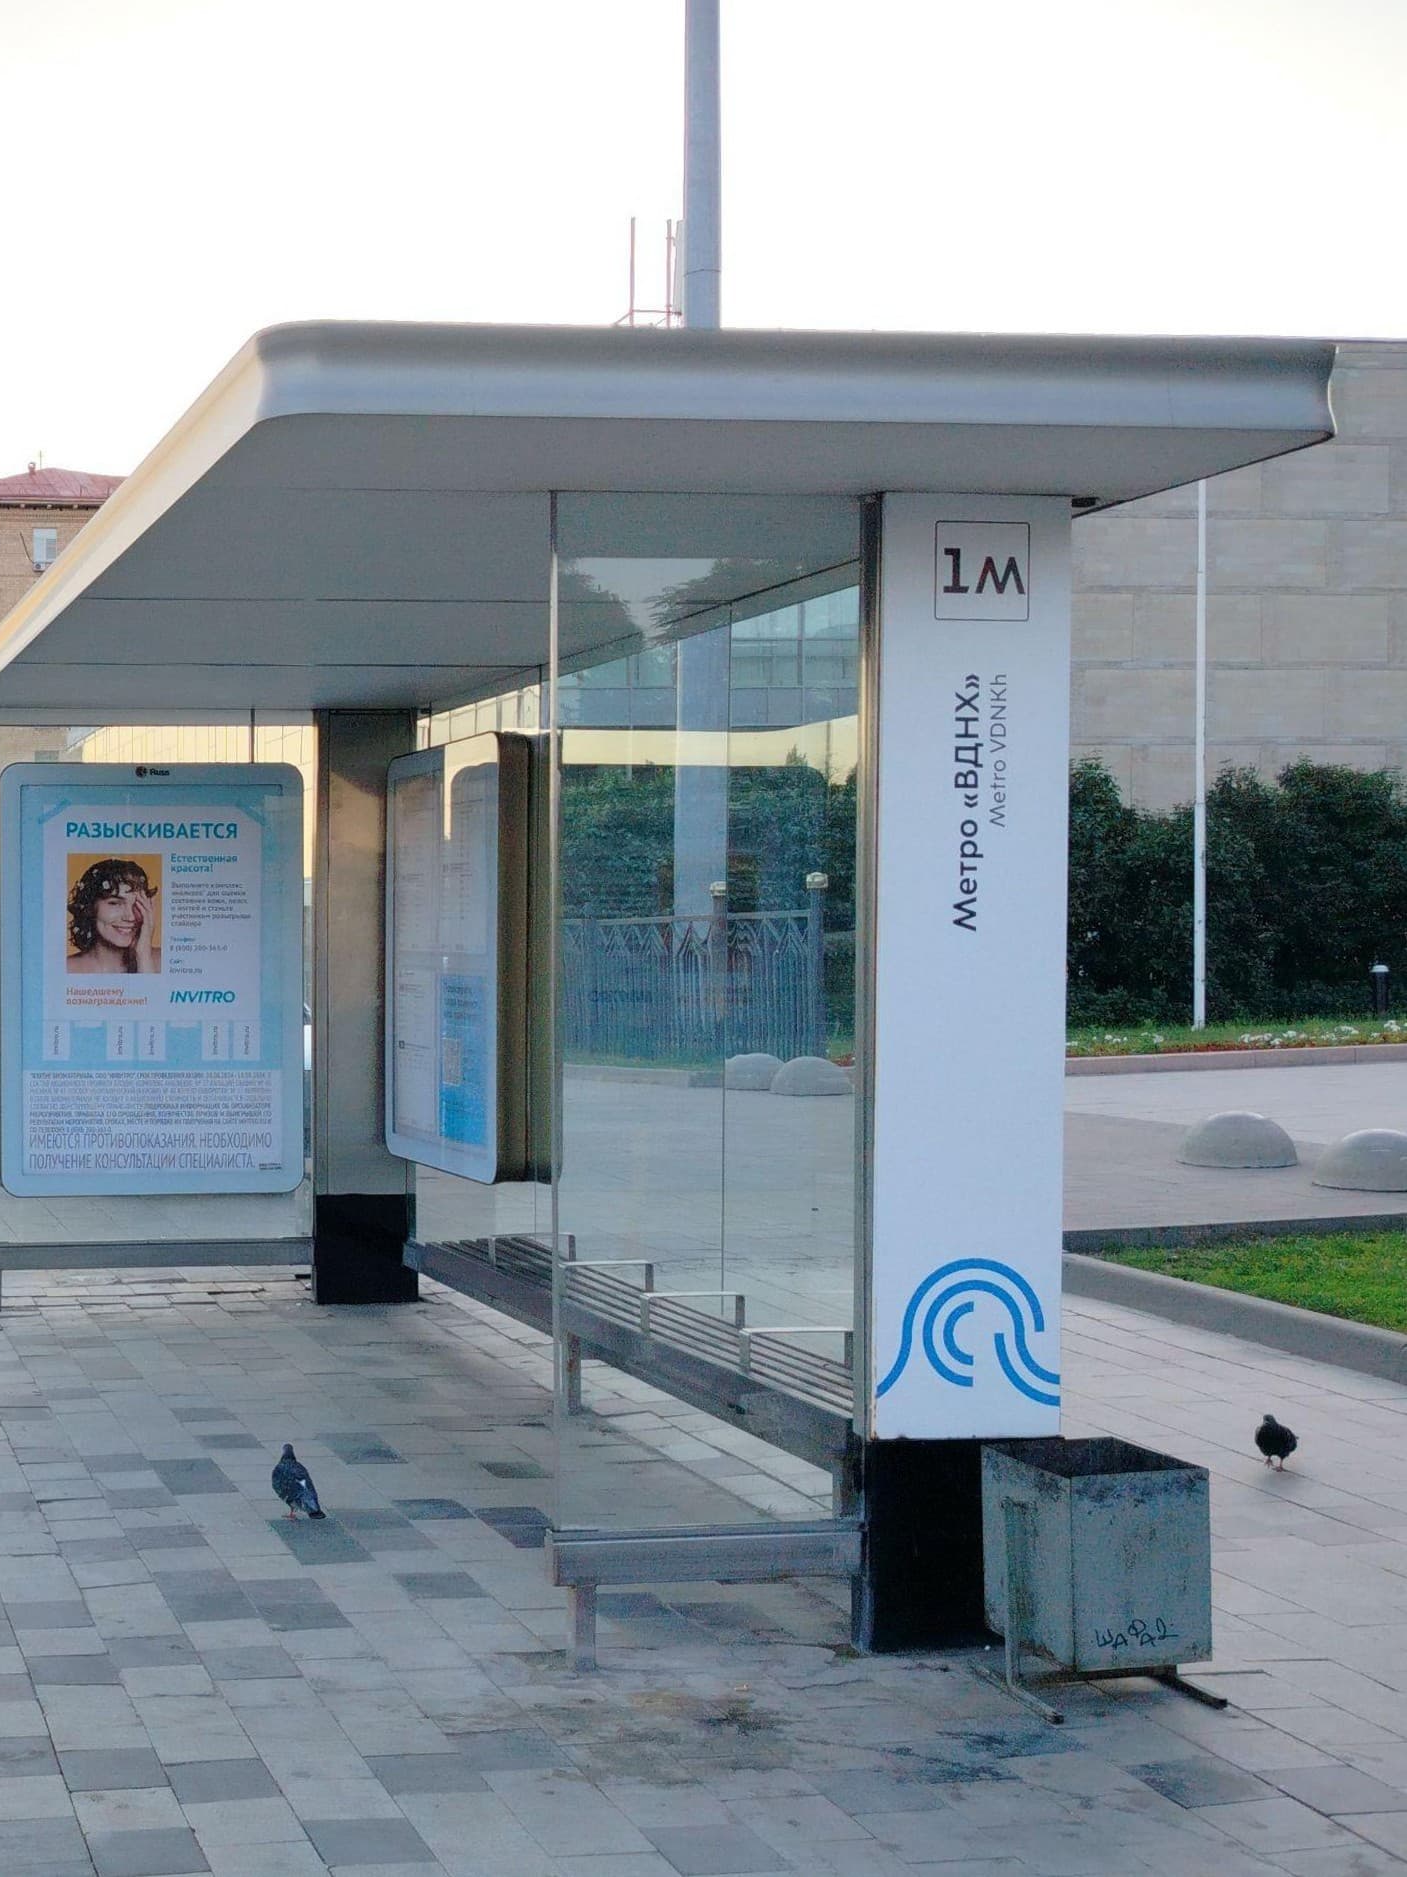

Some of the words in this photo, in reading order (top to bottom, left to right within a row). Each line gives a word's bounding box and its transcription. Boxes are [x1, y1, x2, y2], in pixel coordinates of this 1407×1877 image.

[989, 673, 1007, 753] VDNKh
[953, 673, 983, 809] «ВДНХ»
[989, 757, 1007, 828] Metro
[66, 821, 238, 839] РАЗЫСКИВАЕТСЯ
[170, 853, 238, 863] Естественная
[170, 864, 213, 874] красота!
[952, 820, 984, 932] Метро
[169, 990, 236, 1004] INVITRO
[29, 1132, 80, 1150] ИМЕЮТСЯ
[199, 1132, 273, 1150] НЕОБХОДИМО
[29, 1153, 92, 1170] ПОЛУЧЕНИЕ
[95, 1153, 176, 1171] КОНСУЛЬТАЦИИ
[179, 1152, 256, 1170] СПЕЦИАЛИСТА.
